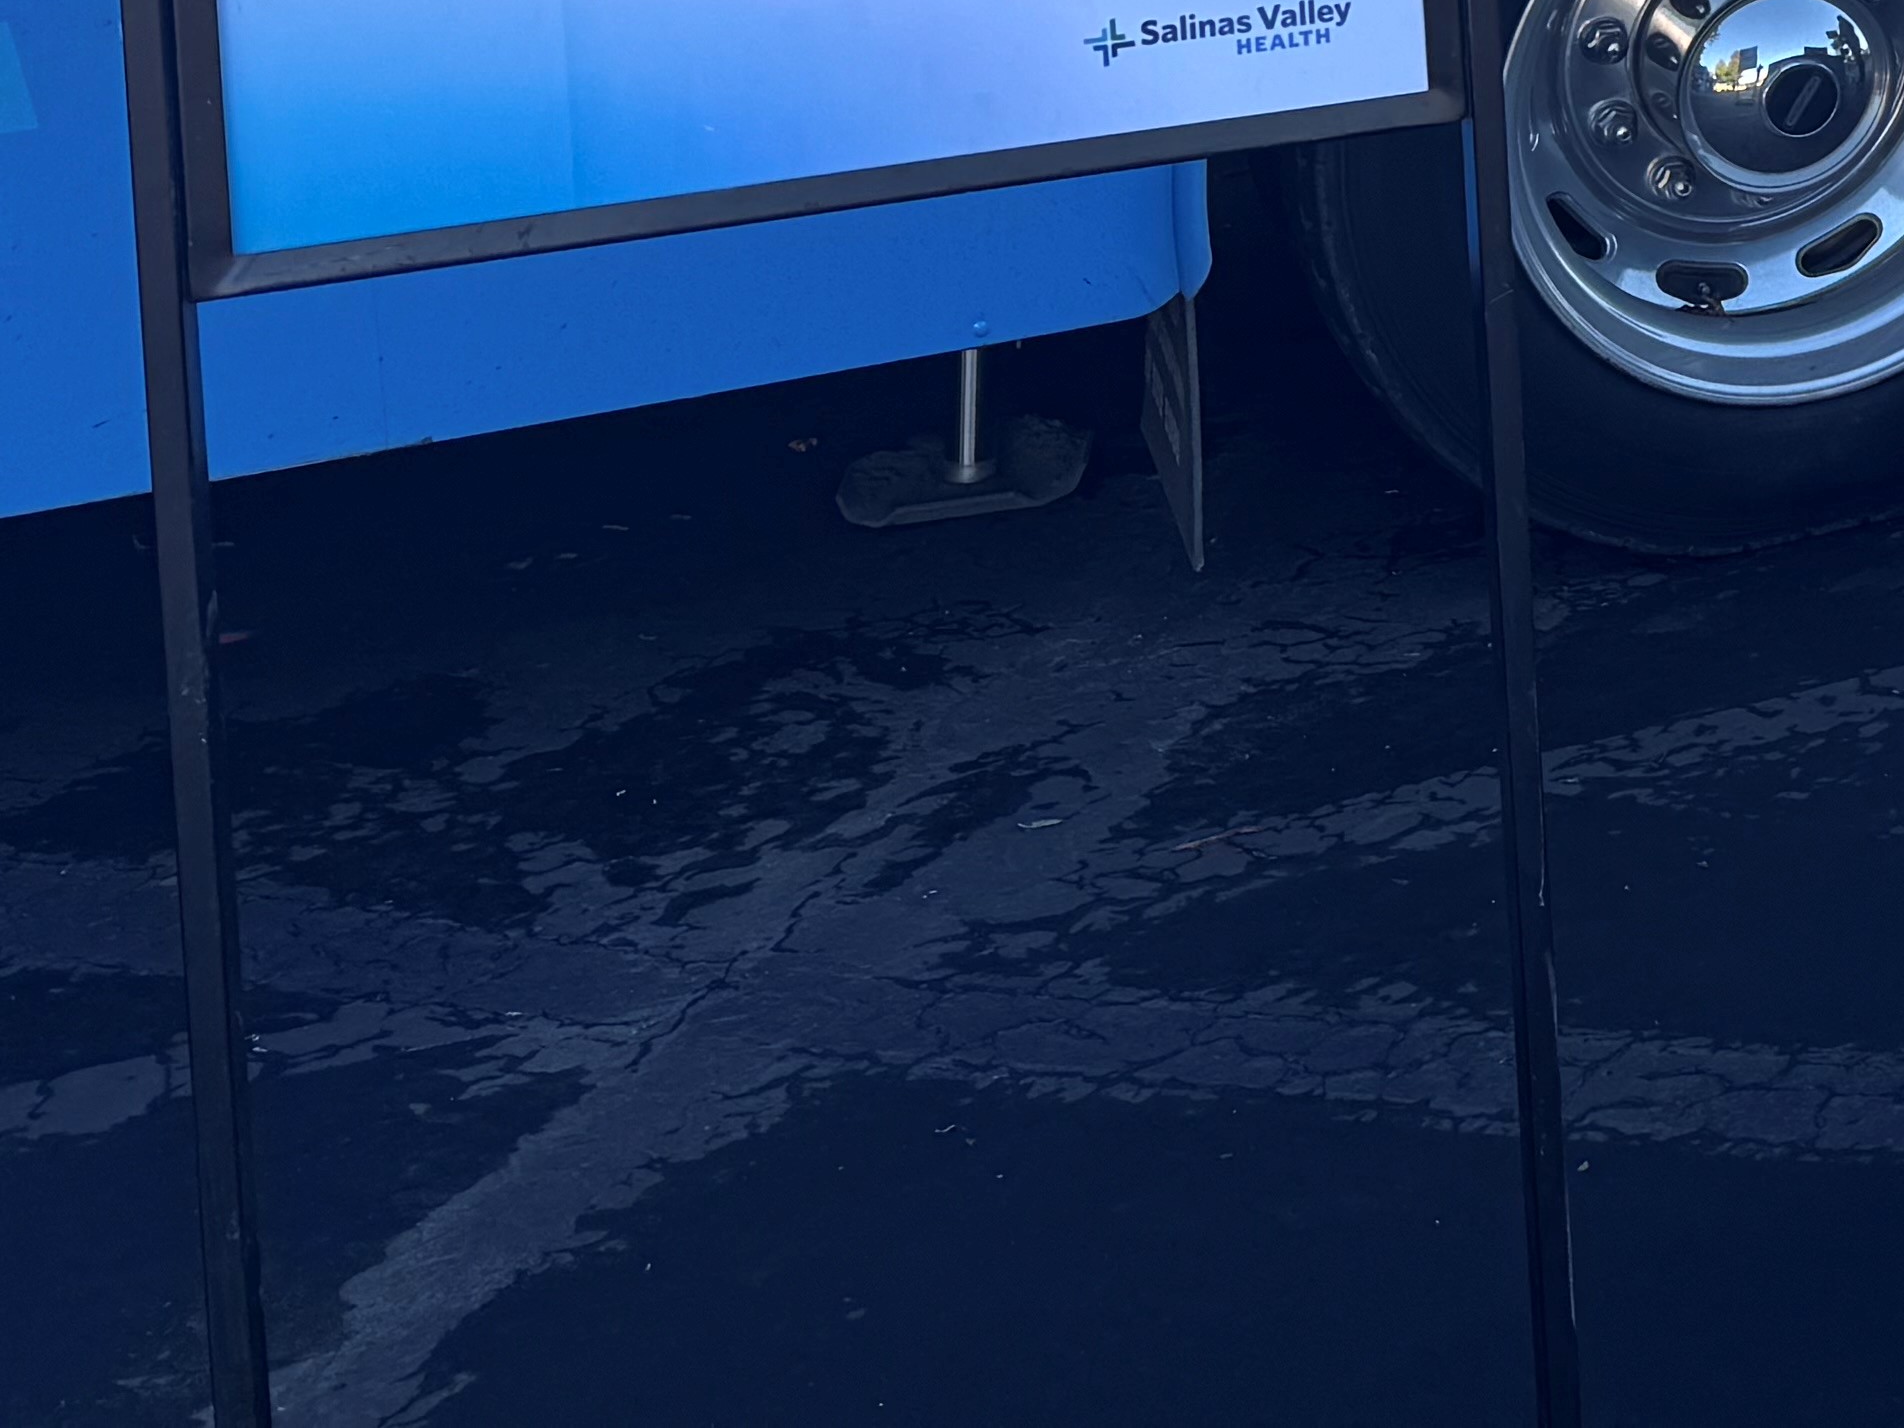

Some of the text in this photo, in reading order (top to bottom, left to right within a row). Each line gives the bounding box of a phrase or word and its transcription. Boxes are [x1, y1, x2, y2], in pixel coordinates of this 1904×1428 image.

[1140, 0, 1352, 46] Salinas Valley
[1236, 27, 1332, 55] HEALTH
